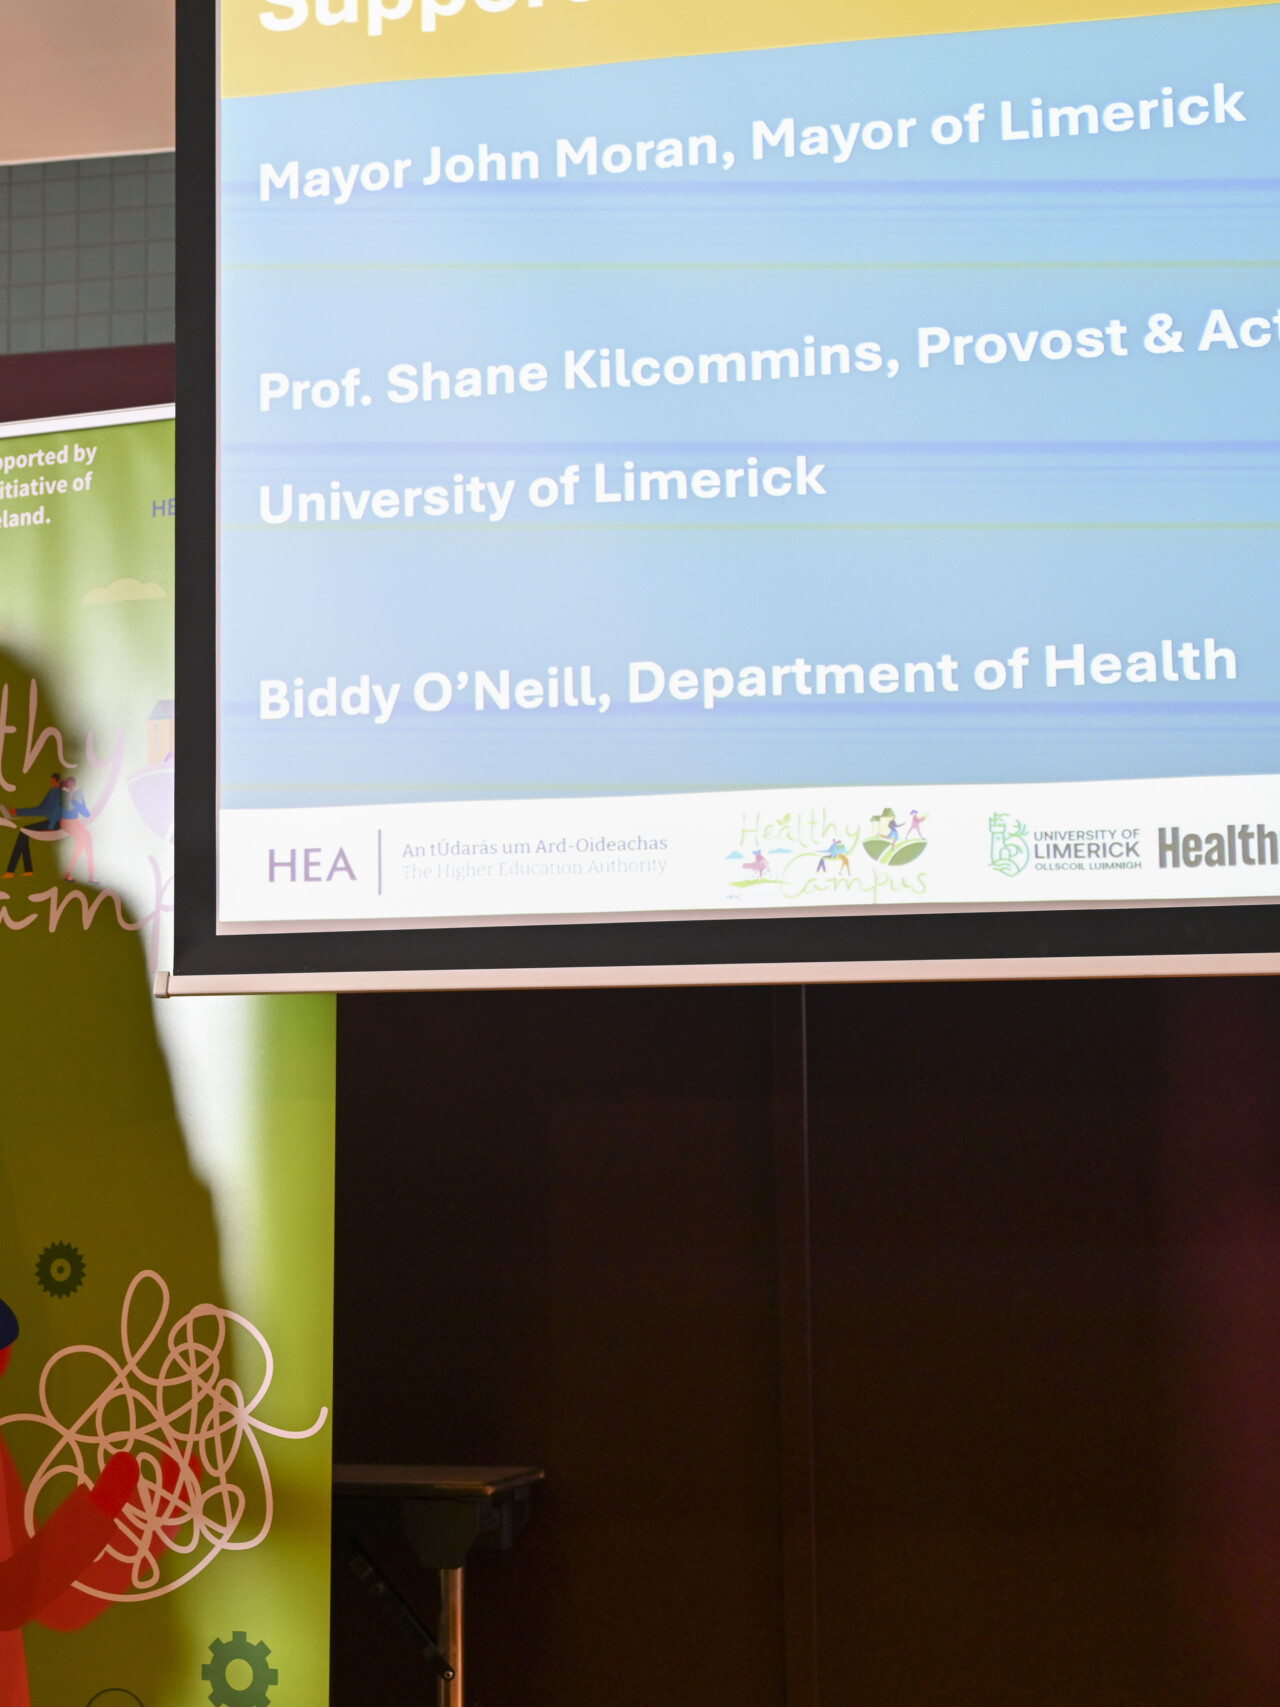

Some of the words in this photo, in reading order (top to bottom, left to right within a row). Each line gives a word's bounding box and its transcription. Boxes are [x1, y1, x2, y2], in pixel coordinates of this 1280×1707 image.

[261, 159, 412, 204] Mayor
[424, 144, 539, 186] John
[557, 135, 735, 178] Moran,
[753, 118, 917, 164] Mayor
[931, 103, 985, 145] of
[1001, 83, 1247, 141] Limerick
[260, 368, 372, 412] Prof.
[387, 361, 548, 404] Shane
[565, 335, 899, 390] Kilcommins,
[918, 319, 1128, 368] Provost
[1144, 313, 1185, 354] &
[73, 443, 98, 466] by
[72, 471, 94, 491] of
[260, 474, 516, 524] University
[528, 464, 580, 508] of
[595, 455, 827, 503] Limerick
[152, 498, 175, 518] HE
[260, 674, 401, 724] Biddy
[413, 665, 611, 713] O’Neill,
[629, 654, 959, 709] Department
[974, 646, 1029, 690] of
[1045, 638, 1237, 687] Health
[739, 806, 861, 855] Healthy
[1034, 829, 1117, 841] UNIVERSITY
[1121, 828, 1141, 840] OF
[1158, 823, 1280, 868] Health
[402, 843, 426, 858] An
[502, 841, 531, 854] um
[535, 835, 669, 854] Ard-Oideachas
[1034, 841, 1140, 859] LIMERICK
[267, 846, 358, 883] HEA
[402, 864, 433, 880] The
[437, 862, 494, 881] Higher
[499, 860, 583, 877] Education
[587, 857, 668, 876] Authority
[781, 852, 928, 904] Campus
[1035, 862, 1086, 871] OLLSCOIL
[1089, 861, 1142, 870] LUIMNIGH
